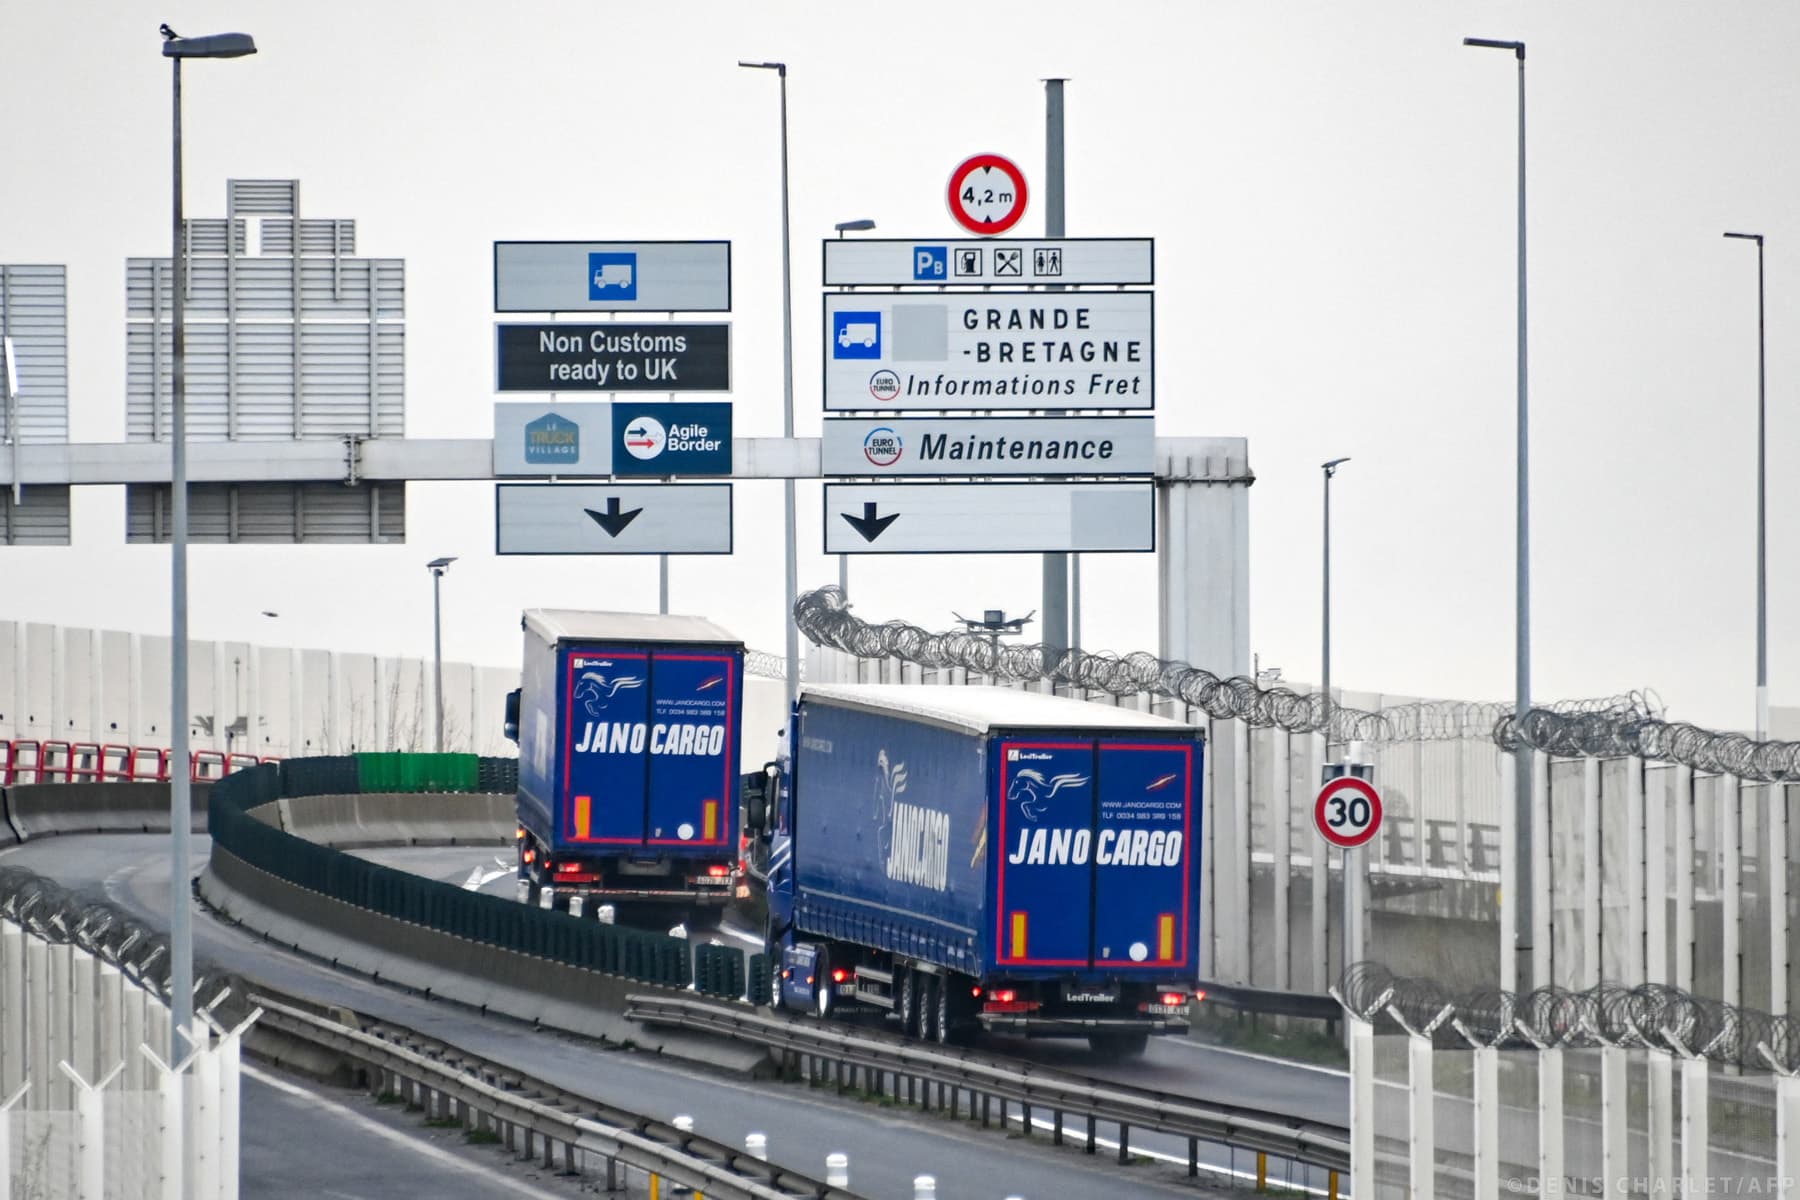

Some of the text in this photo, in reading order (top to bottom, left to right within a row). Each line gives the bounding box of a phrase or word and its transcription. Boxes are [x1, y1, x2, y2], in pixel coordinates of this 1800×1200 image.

[962, 187, 1013, 206] 4,2 m
[963, 308, 1091, 330] GRANDE
[539, 330, 687, 353] Non Customs
[963, 341, 1142, 363] -BRETAGNE
[549, 358, 678, 385] ready to UK
[875, 378, 894, 386] EURO
[872, 385, 897, 393] TUNNEL
[906, 373, 1141, 396] Informations Fret
[529, 431, 575, 445] TRUCK
[668, 424, 708, 439] Agile
[872, 438, 894, 447] EURO
[528, 446, 576, 454] VILLAGE
[667, 439, 722, 452] Border
[867, 446, 898, 456] TUNNEL
[919, 433, 1114, 460] Maintenance
[575, 722, 725, 756] JANO CARGO
[1327, 797, 1370, 828] 30
[886, 801, 950, 892] JANOCARGO
[1008, 828, 1183, 867] JANO CARGO
